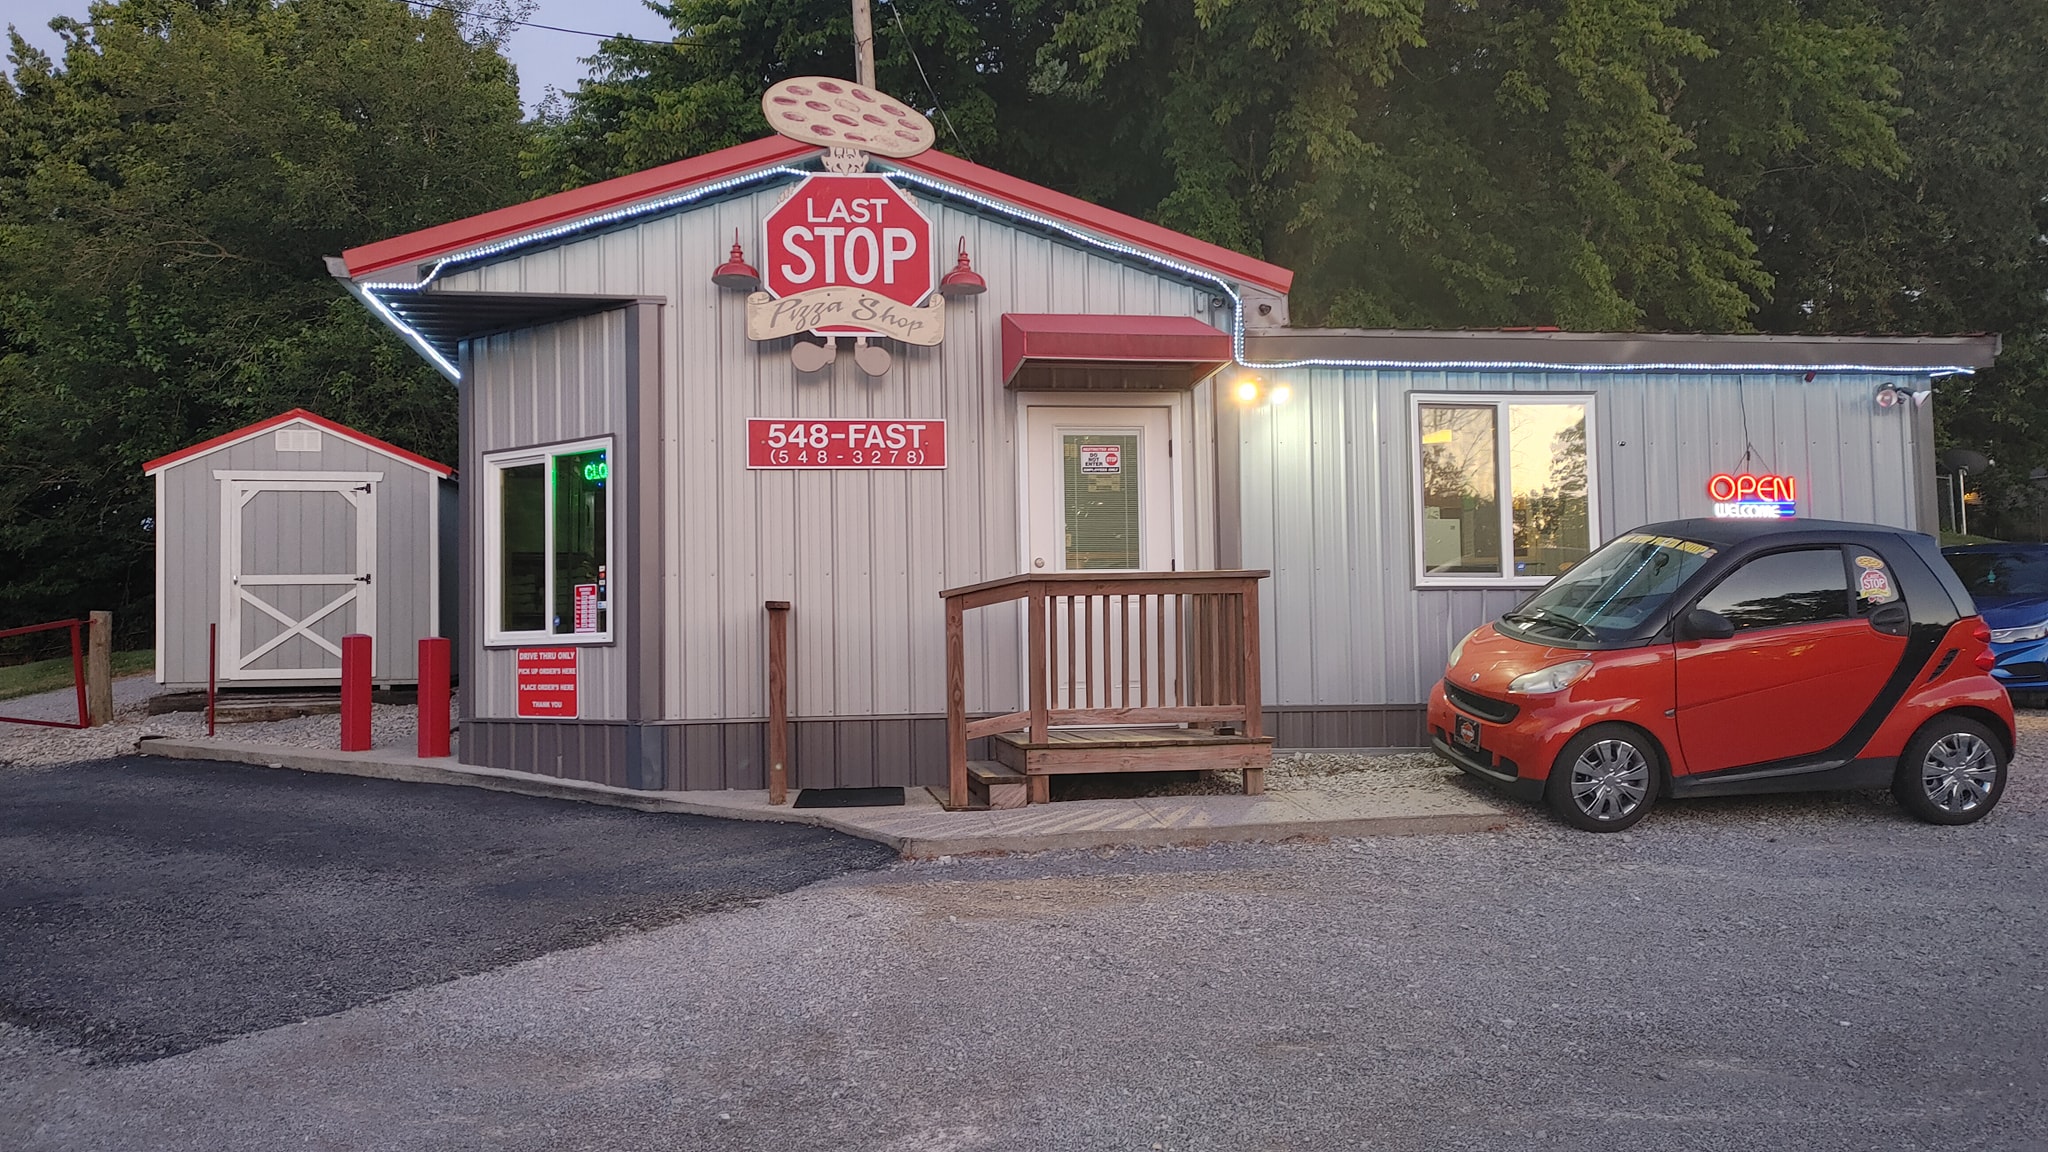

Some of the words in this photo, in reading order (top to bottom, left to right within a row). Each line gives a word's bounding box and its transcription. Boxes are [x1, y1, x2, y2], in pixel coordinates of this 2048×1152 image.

[806, 197, 889, 224] LAST
[781, 225, 917, 285] STOP
[769, 298, 844, 331] Pizza
[851, 297, 925, 337] Shop
[767, 423, 927, 449] 548-FAST
[1709, 474, 1796, 502] OPEN
[1713, 502, 1781, 518] WELCOME
[1863, 578, 1885, 589] STOP
[520, 652, 538, 660] DRIVE
